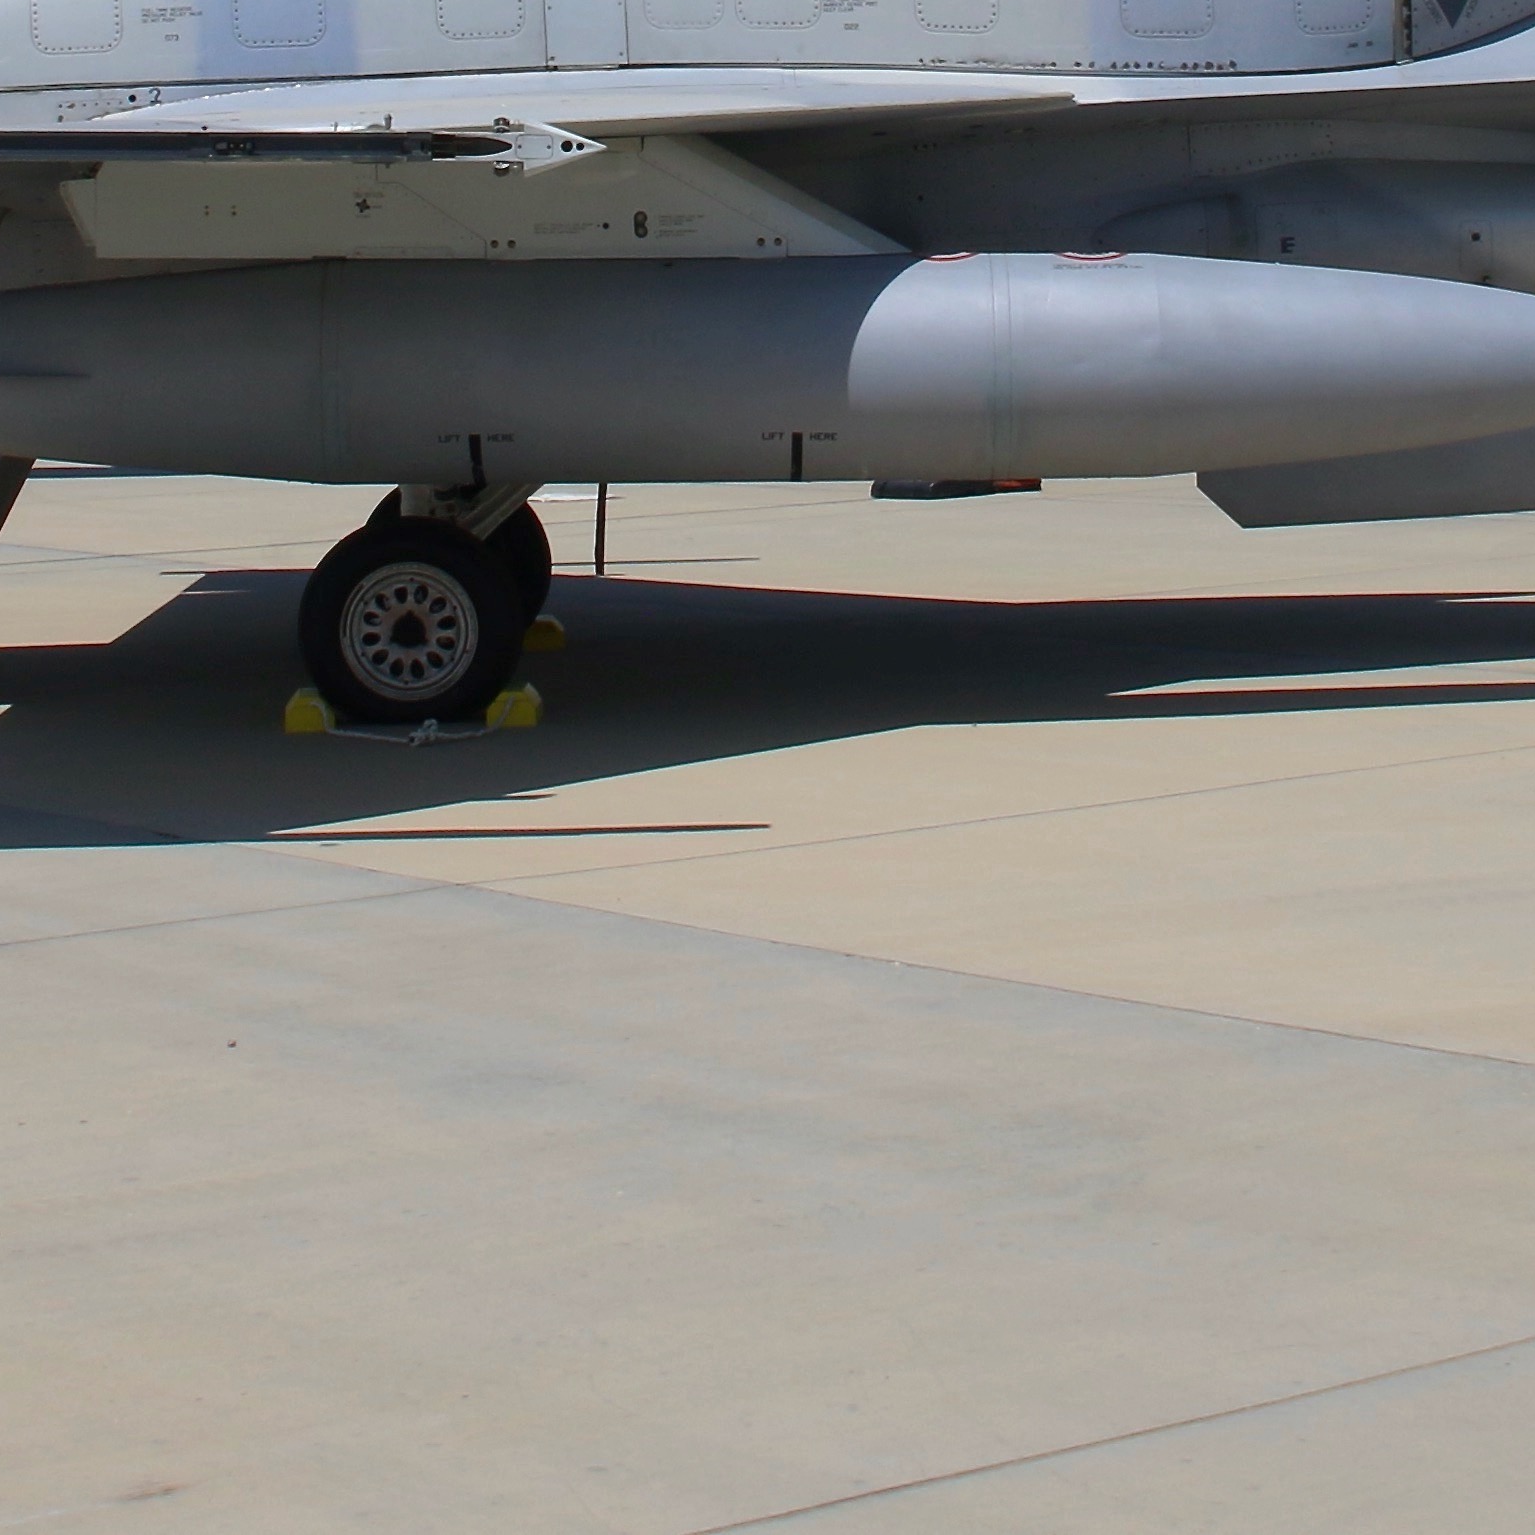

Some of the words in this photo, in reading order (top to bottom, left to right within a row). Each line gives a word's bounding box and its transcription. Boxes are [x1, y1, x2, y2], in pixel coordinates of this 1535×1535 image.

[1280, 237, 1295, 254] E
[438, 434, 461, 443] LIFT
[487, 433, 514, 443] HERE
[762, 431, 785, 440] LIFT
[809, 431, 838, 441] HERE
